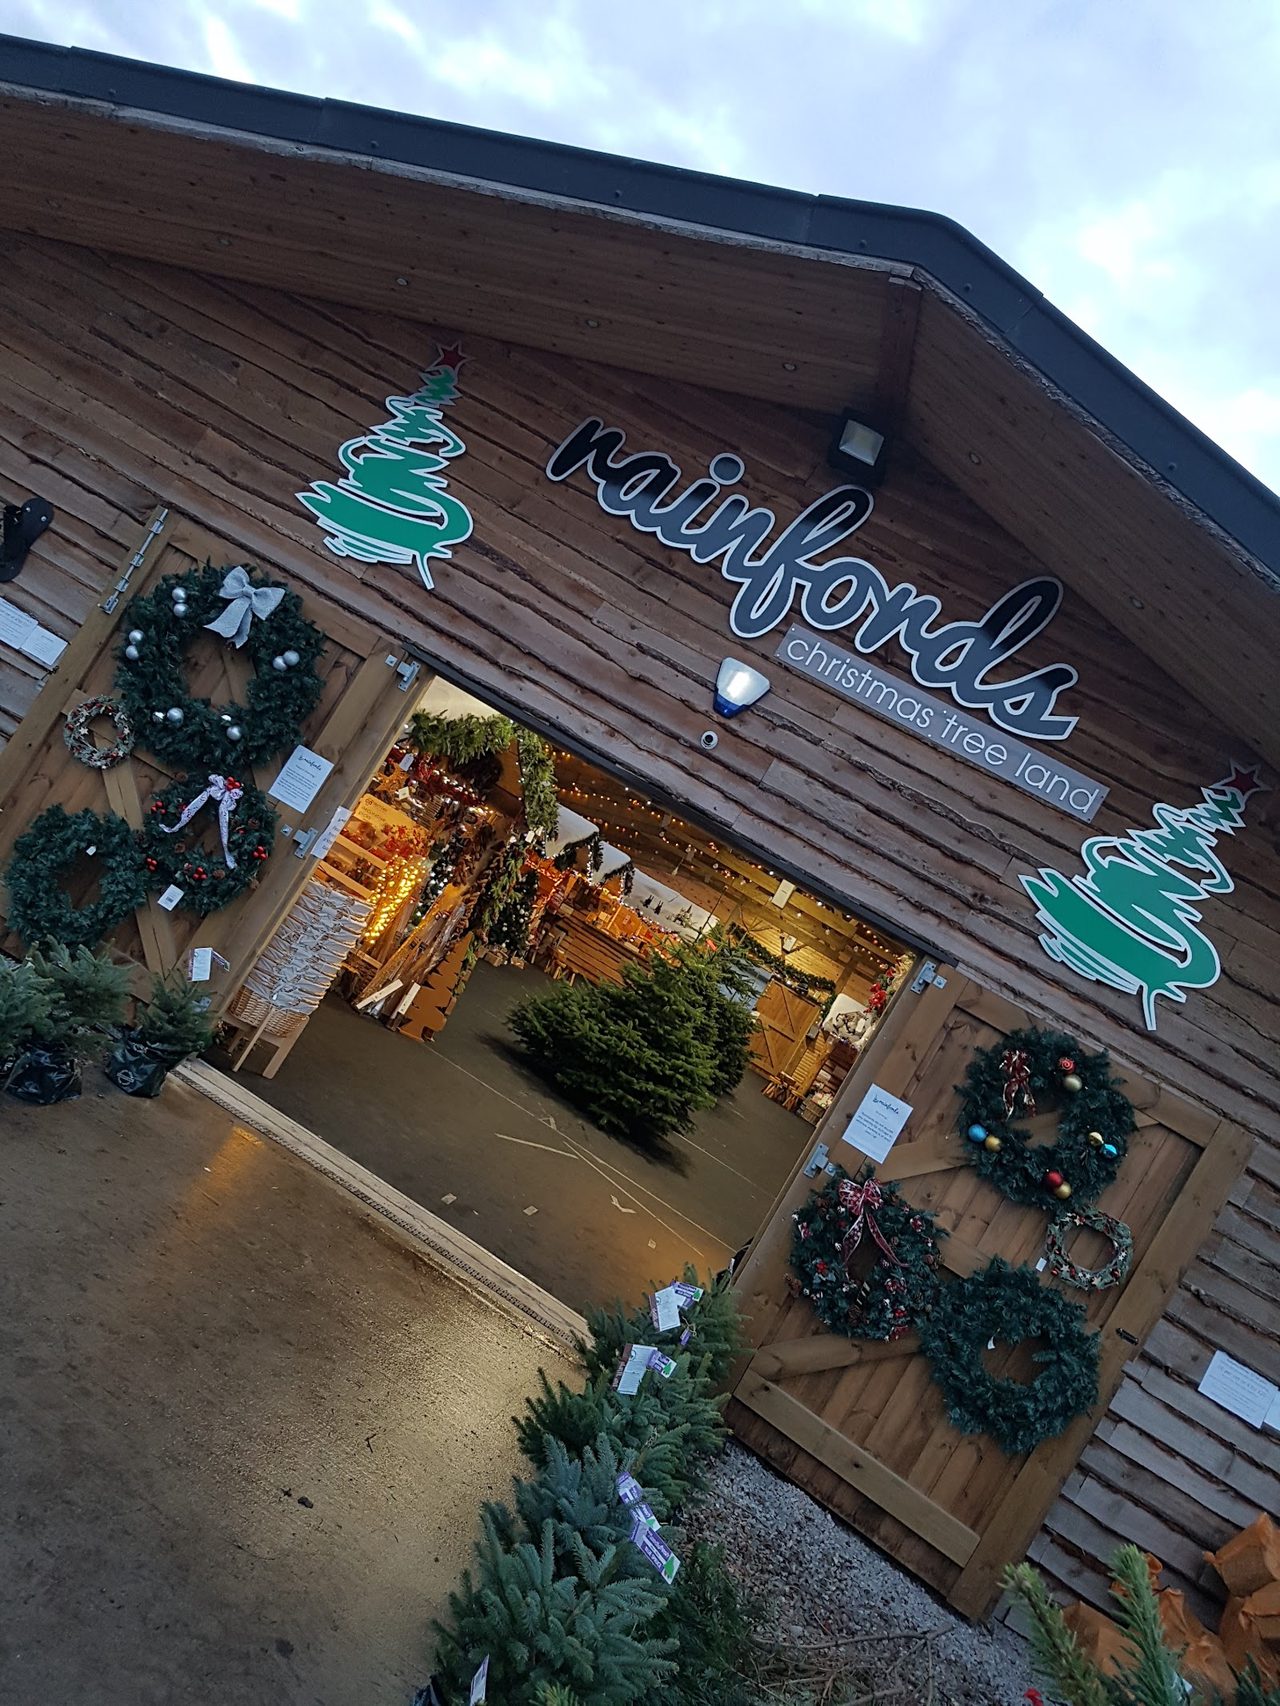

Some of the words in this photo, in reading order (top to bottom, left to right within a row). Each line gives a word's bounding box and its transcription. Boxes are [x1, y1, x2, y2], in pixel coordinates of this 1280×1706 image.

[546, 416, 1079, 740] rainfords
[786, 637, 933, 728] christmas
[939, 710, 1008, 766] tree
[1014, 752, 1099, 814] land
